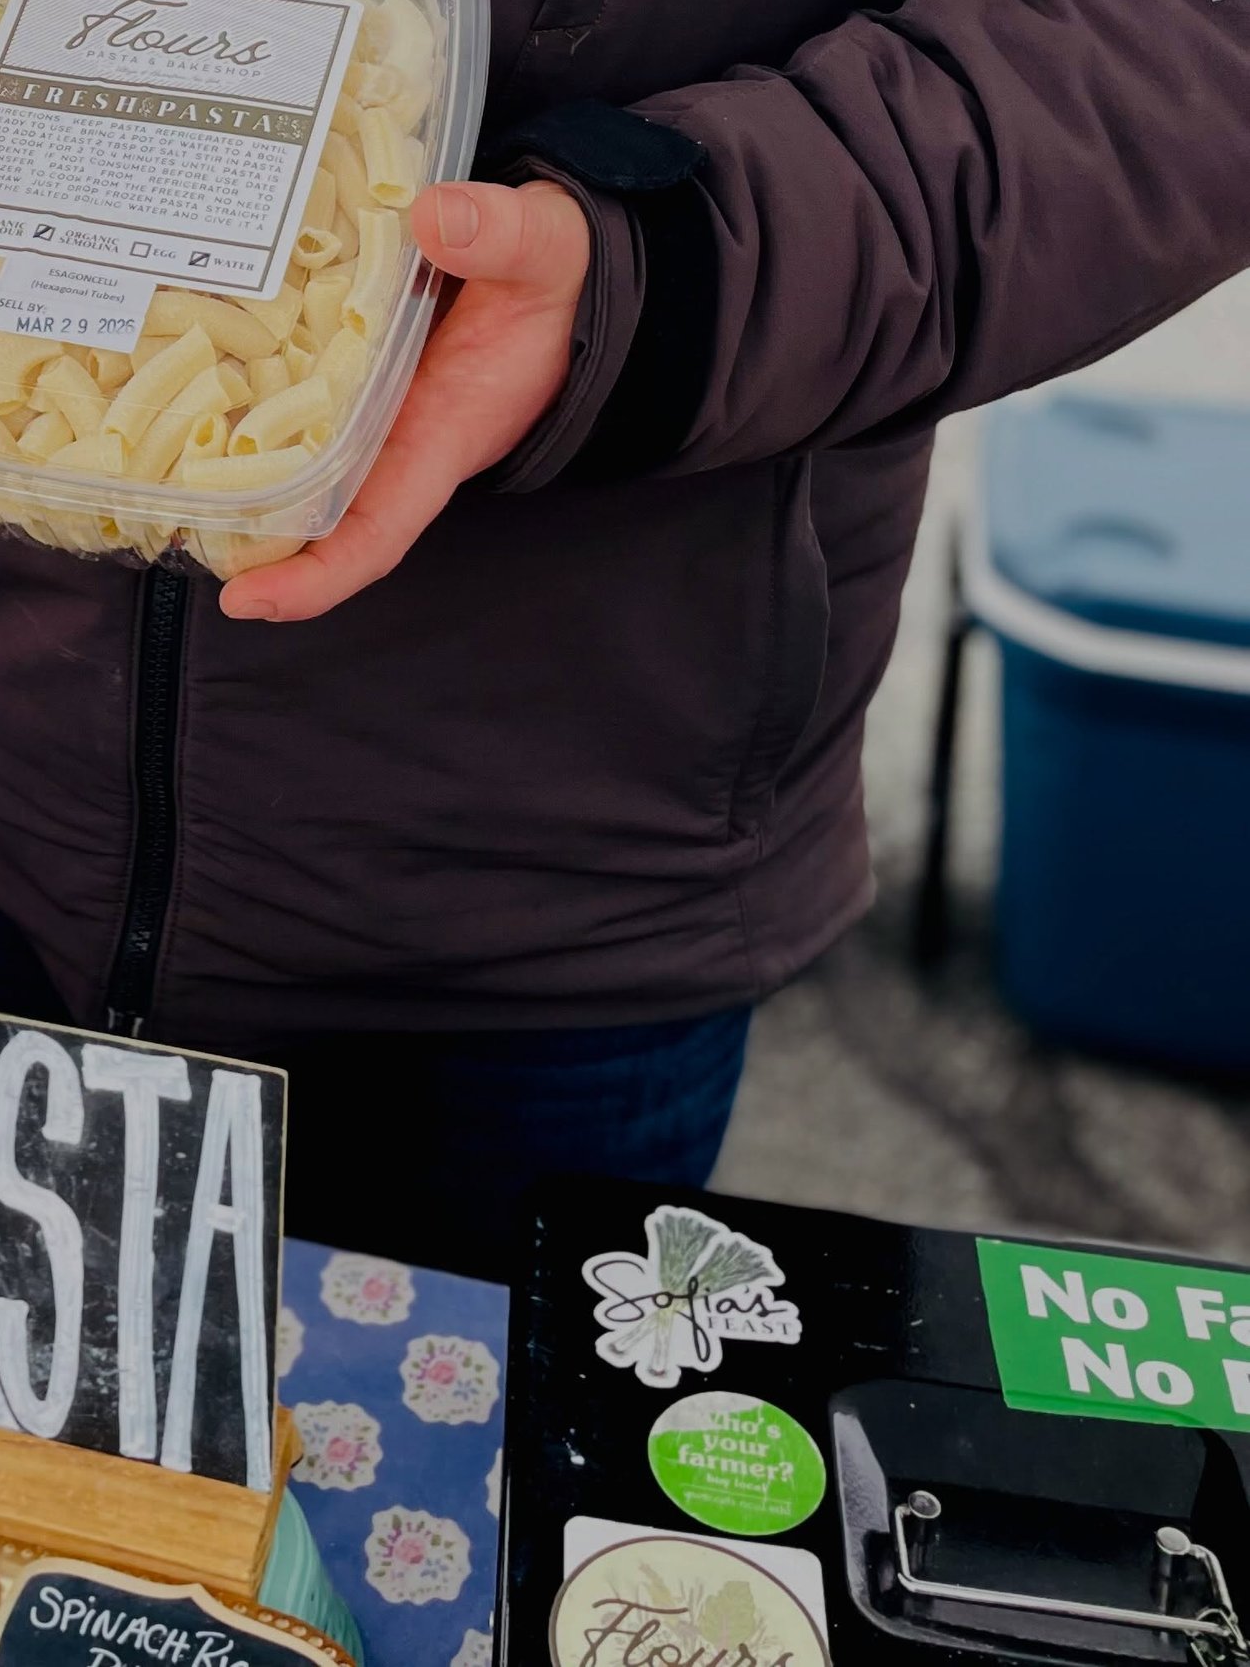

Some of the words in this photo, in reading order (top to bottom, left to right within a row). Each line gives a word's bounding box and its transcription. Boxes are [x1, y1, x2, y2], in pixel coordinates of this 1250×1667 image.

[86, 50, 138, 64] PASTA
[166, 61, 261, 78] BAKESHOP
[23, 84, 140, 113] FRESH
[157, 100, 271, 133] PASTA
[12, 128, 37, 137] ADD
[55, 134, 92, 145] LEAST
[105, 140, 137, 151] TBSP
[194, 152, 222, 162] STIR
[242, 160, 282, 172] PASTA
[72, 117, 103, 127] KEEP
[109, 122, 147, 133] PASTA
[154, 127, 244, 146] REFRIGERATED
[250, 141, 288, 153] UNTIL
[79, 127, 115, 139] BRING
[130, 133, 154, 143] POT
[178, 140, 219, 152] WATER
[10, 137, 43, 148] COOK
[48, 142, 72, 152] FOR
[122, 152, 175, 166] MINUTES
[180, 160, 216, 172] UNTIL
[221, 167, 261, 179] PASTA
[60, 153, 84, 163] NOT
[88, 156, 156, 174] CONSUMED
[161, 167, 209, 181] BEFORE
[214, 175, 239, 185] USE
[244, 181, 277, 192] DATE
[48, 161, 86, 173] PASTA
[99, 169, 133, 180] FROM
[147, 175, 239, 196] REFRIGERATOR
[48, 171, 82, 182] COOK
[84, 175, 120, 188] FROM
[124, 182, 147, 192] THE
[236, 199, 271, 211] NEED
[24, 187, 69, 200] SALTED
[73, 193, 122, 208] BOILING
[126, 202, 168, 215] WATER
[172, 209, 198, 220] AND
[203, 214, 233, 226] GIVE
[31, 178, 61, 189] JUST
[66, 182, 100, 195] DROP
[104, 189, 153, 203] FROZEN
[158, 197, 199, 210] PASTA
[204, 204, 267, 221] STRAIGHT
[57, 236, 119, 253] SEMOLINA
[64, 229, 120, 245] ORGANIC
[152, 248, 177, 259] EGG
[49, 268, 119, 287] ESAGONCELLI
[212, 257, 255, 271] WATER
[31, 280, 88, 296] (Hexagonal
[91, 290, 125, 304] Tubes)
[16, 317, 54, 333] MAR
[592, 1260, 788, 1362] Sofia's
[1020, 1264, 1149, 1331] No
[707, 1316, 792, 1336] FEAST
[1060, 1336, 1195, 1406] No
[678, 1444, 794, 1482] farmer?
[702, 1434, 770, 1457] your
